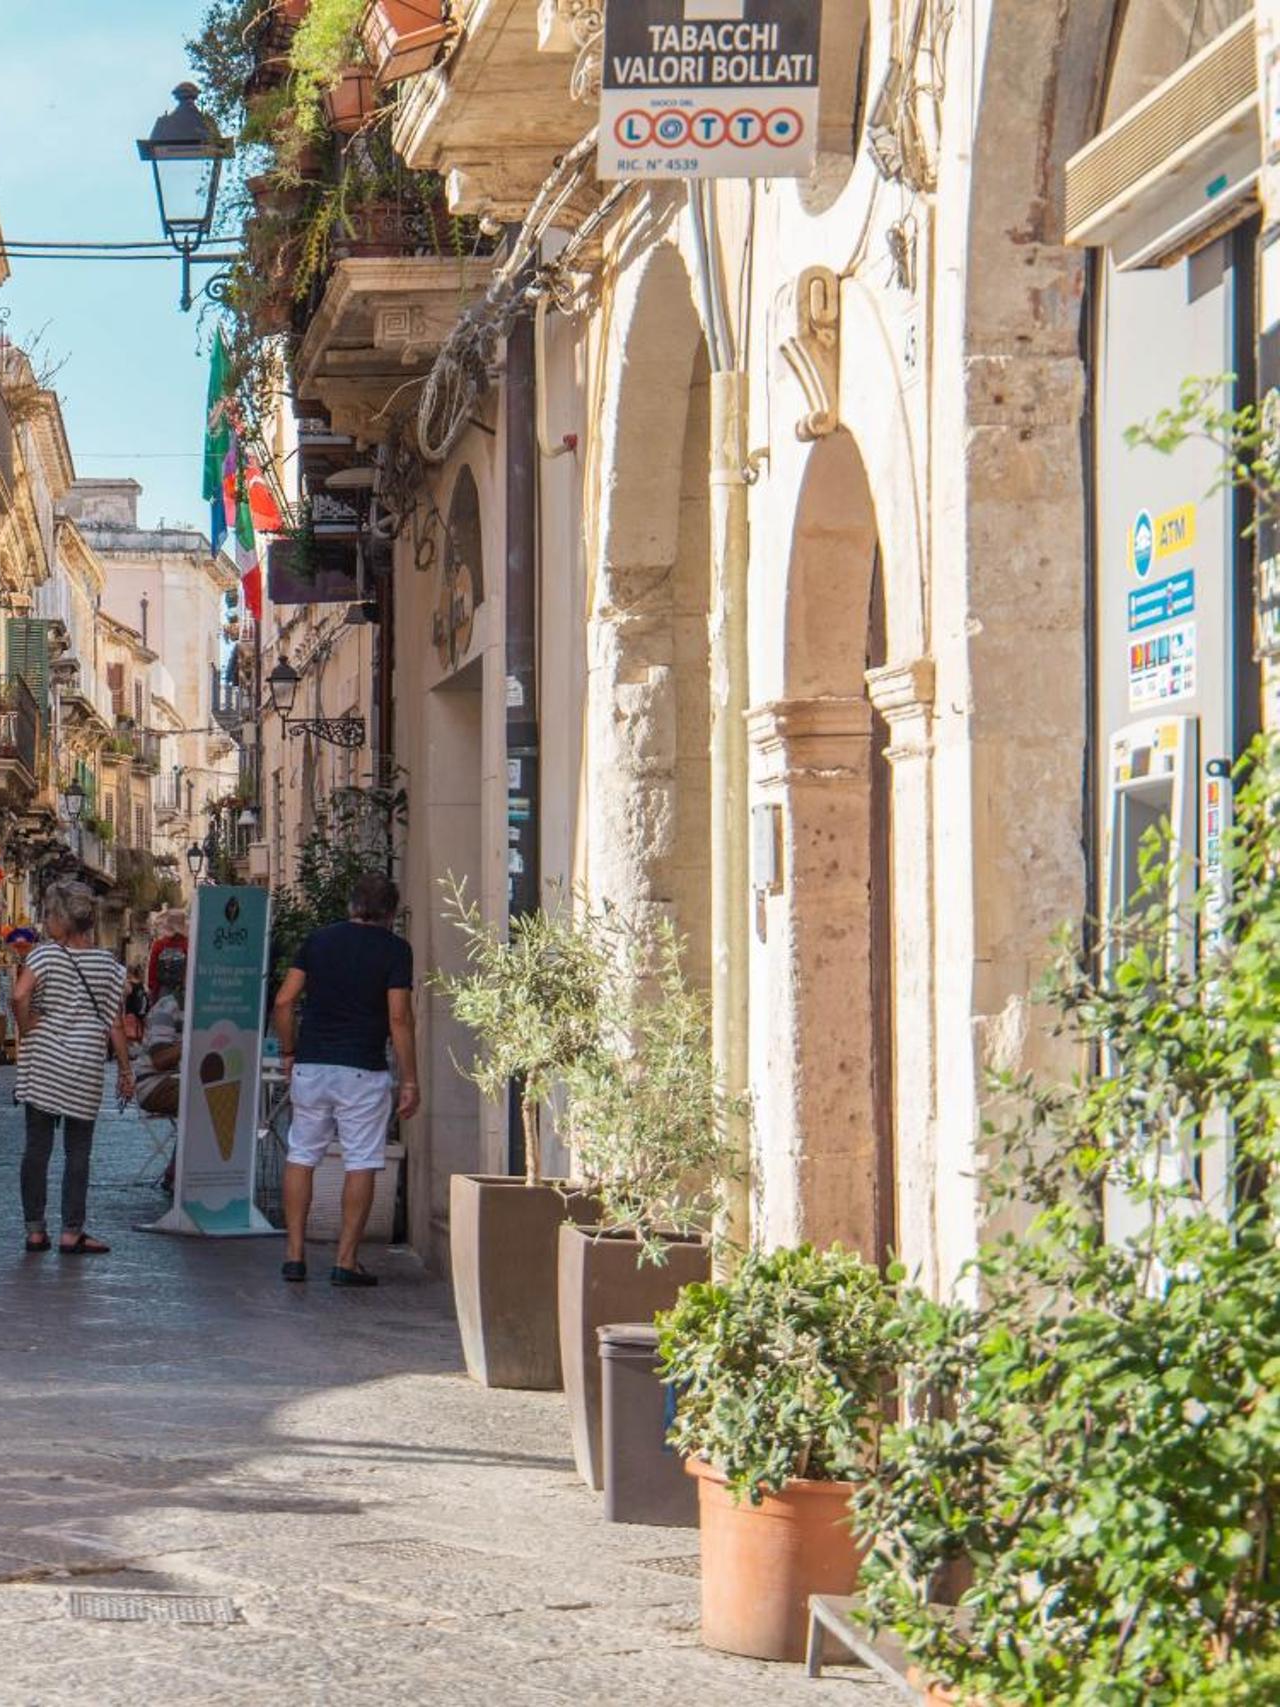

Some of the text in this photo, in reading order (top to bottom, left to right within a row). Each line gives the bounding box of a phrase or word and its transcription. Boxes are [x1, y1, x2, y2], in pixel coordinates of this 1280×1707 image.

[648, 23, 778, 52] TABACCHI
[613, 54, 813, 84] VALORI BOLLATI
[614, 107, 803, 149] LOTTO
[666, 158, 698, 171] 4539
[1160, 516, 1185, 546] ATM
